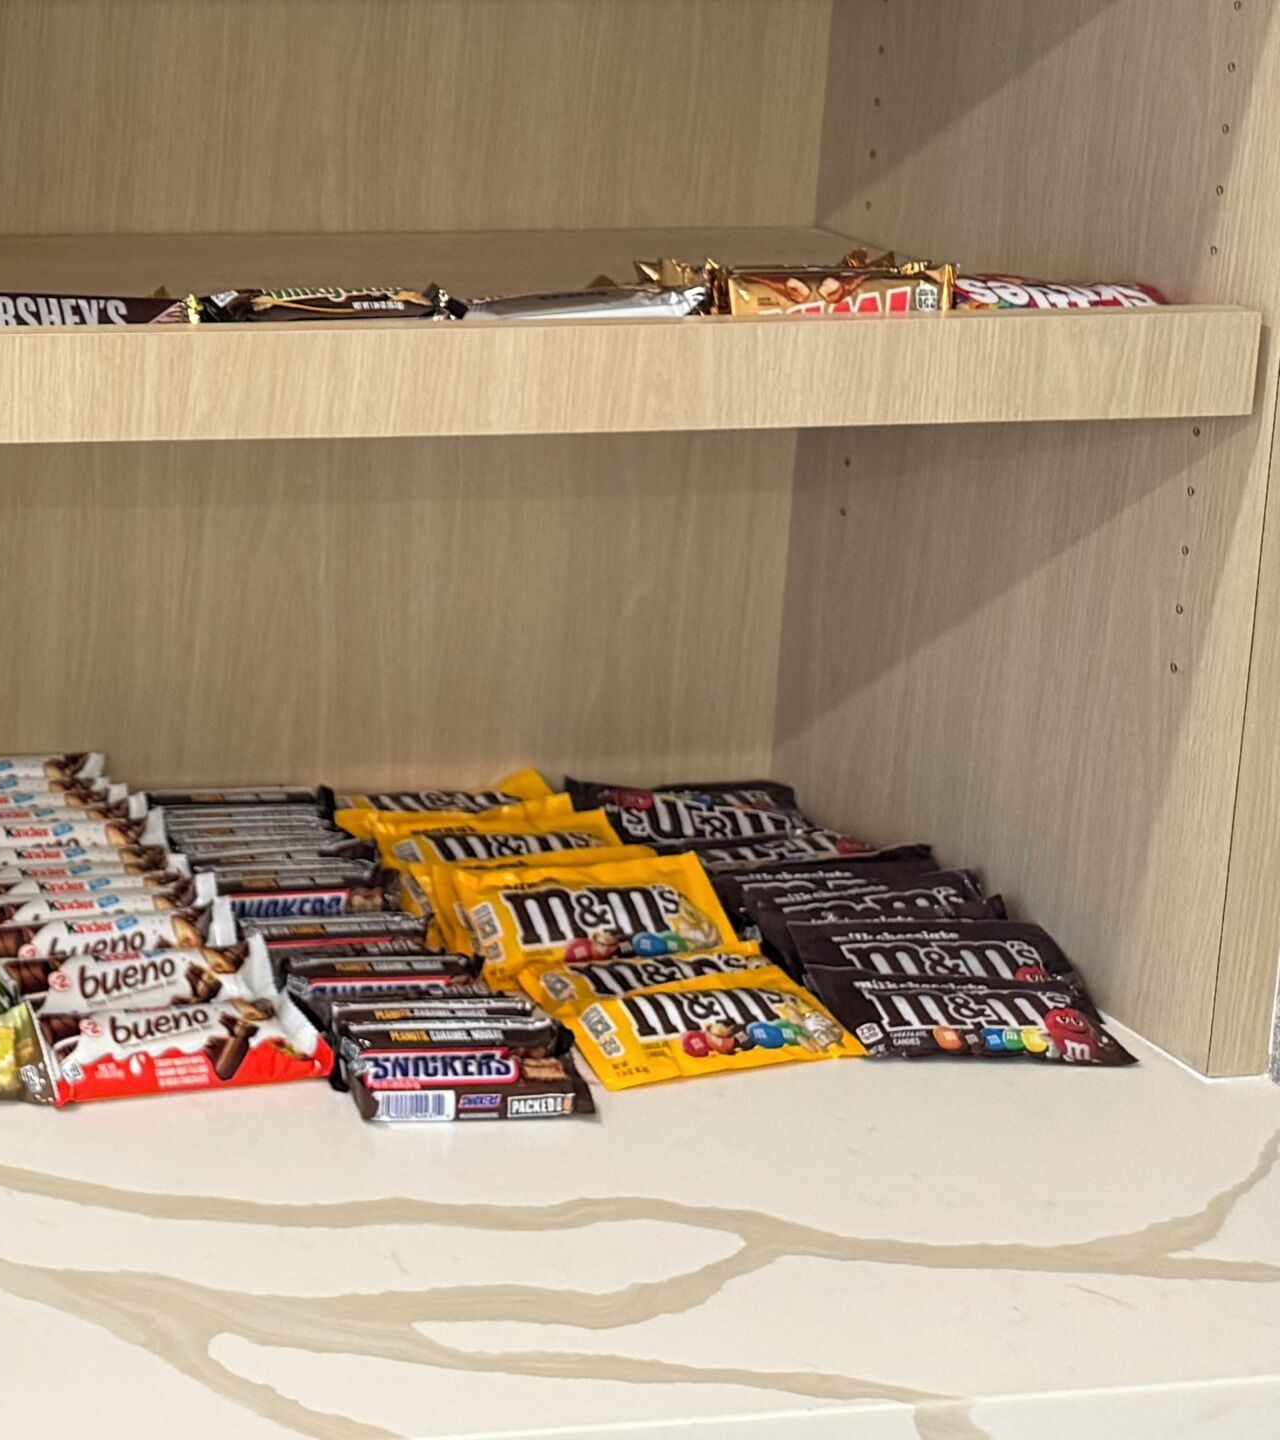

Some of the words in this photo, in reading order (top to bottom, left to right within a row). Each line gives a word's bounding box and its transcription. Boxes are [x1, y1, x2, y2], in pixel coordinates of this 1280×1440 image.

[48, 897, 96, 913] Kinder
[503, 882, 683, 948] m&m's
[77, 956, 178, 1000] bueno
[108, 1006, 211, 1046] bueno
[863, 987, 1082, 1033] m&m's
[368, 1054, 515, 1080] SNICKERS
[510, 1098, 556, 1115] PACKED
